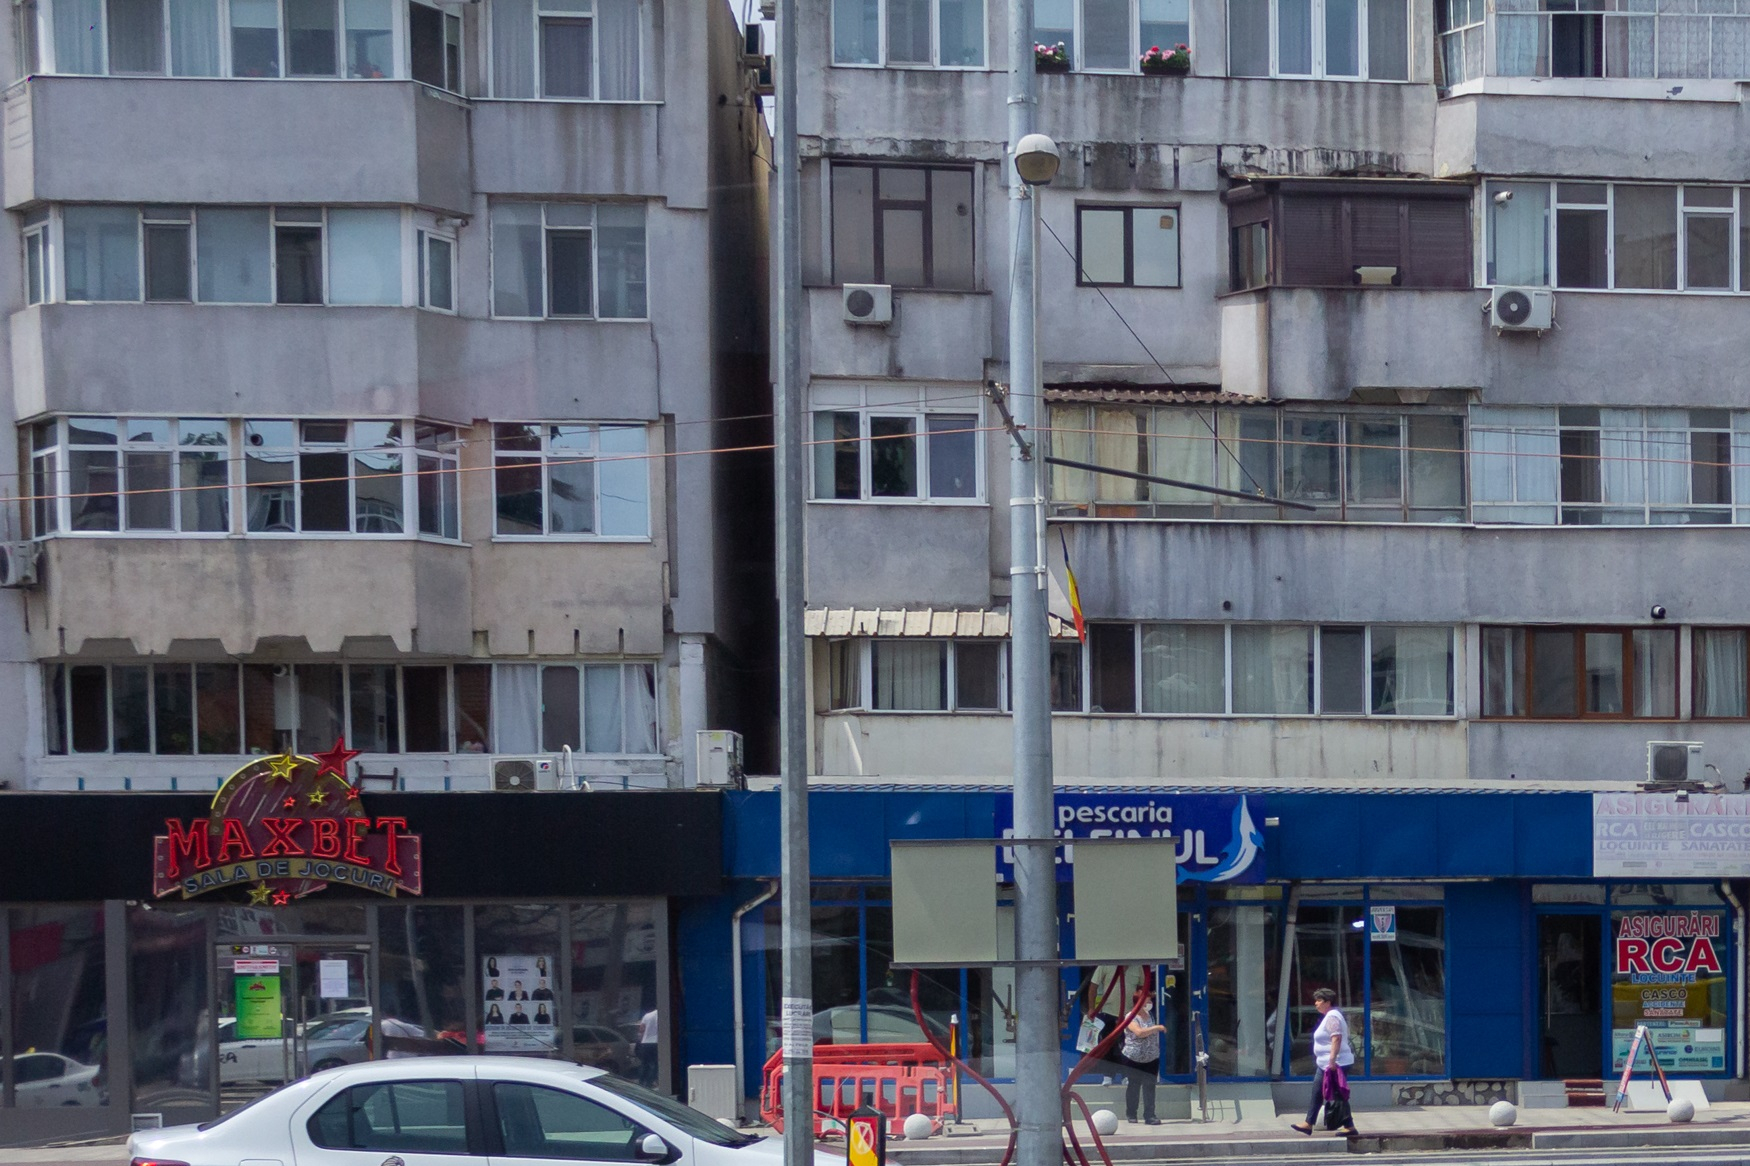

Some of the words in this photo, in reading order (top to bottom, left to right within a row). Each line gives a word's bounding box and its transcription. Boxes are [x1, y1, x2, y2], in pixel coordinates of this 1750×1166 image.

[1058, 801, 1173, 828] pescaria
[1596, 821, 1638, 837] RCA
[165, 816, 407, 878] MAXBET
[1600, 841, 1670, 851] LOCUINTE
[184, 864, 250, 893] SALA
[256, 859, 291, 877] DE
[299, 861, 394, 892] JOCURI
[1619, 910, 1720, 938] ASIGURĂRI
[1617, 936, 1722, 974] RCA
[1641, 988, 1688, 1000] CASCO
